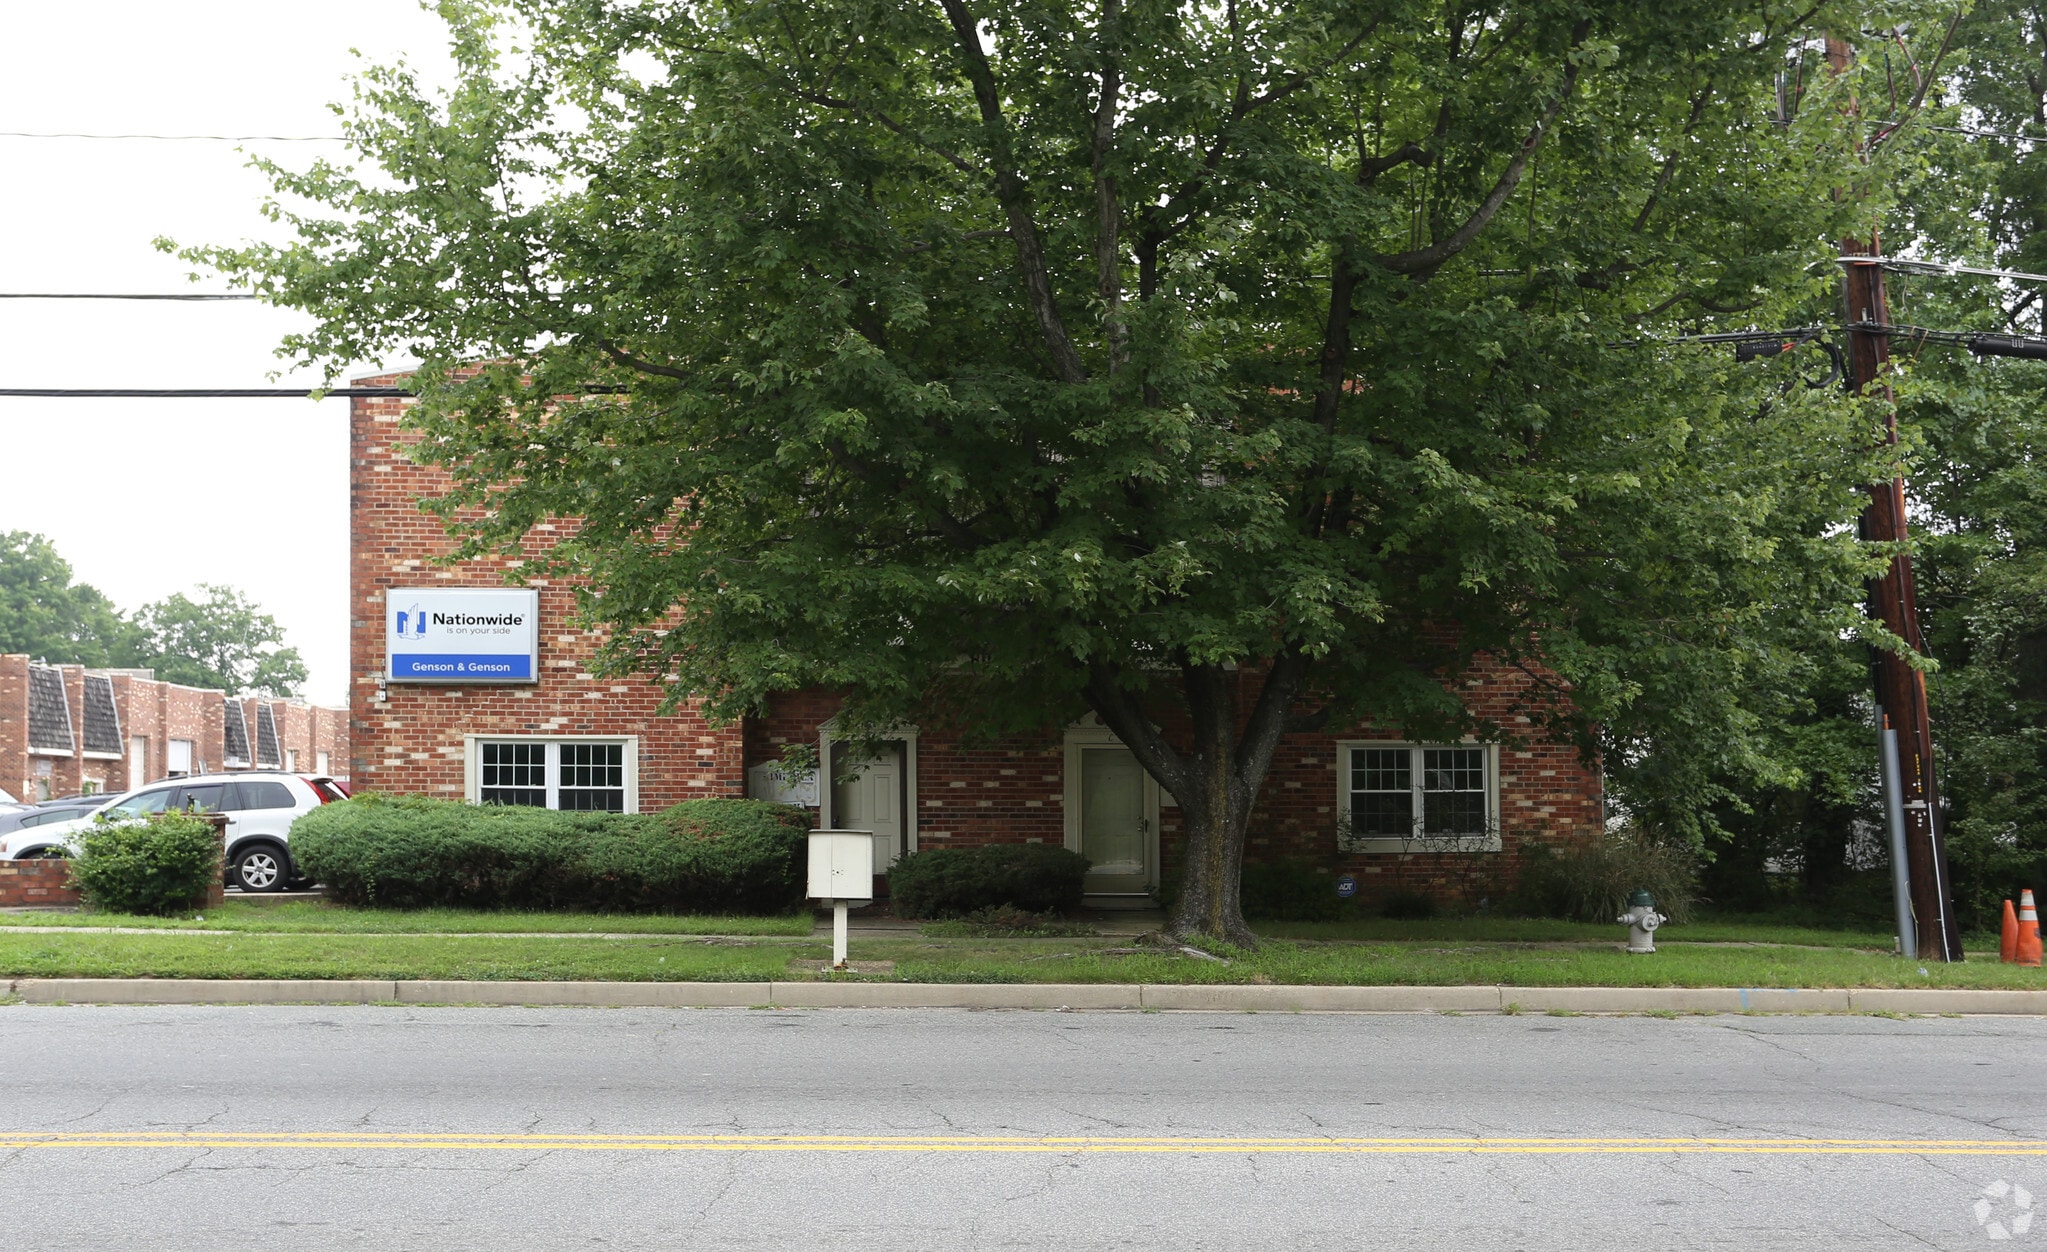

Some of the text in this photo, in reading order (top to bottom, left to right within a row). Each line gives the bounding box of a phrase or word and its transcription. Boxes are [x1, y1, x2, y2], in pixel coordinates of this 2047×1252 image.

[446, 626, 453, 634] is
[470, 627, 490, 635] your
[492, 626, 511, 634] side
[412, 662, 511, 672] Genson & Genson
[1338, 883, 1353, 891] ADT
